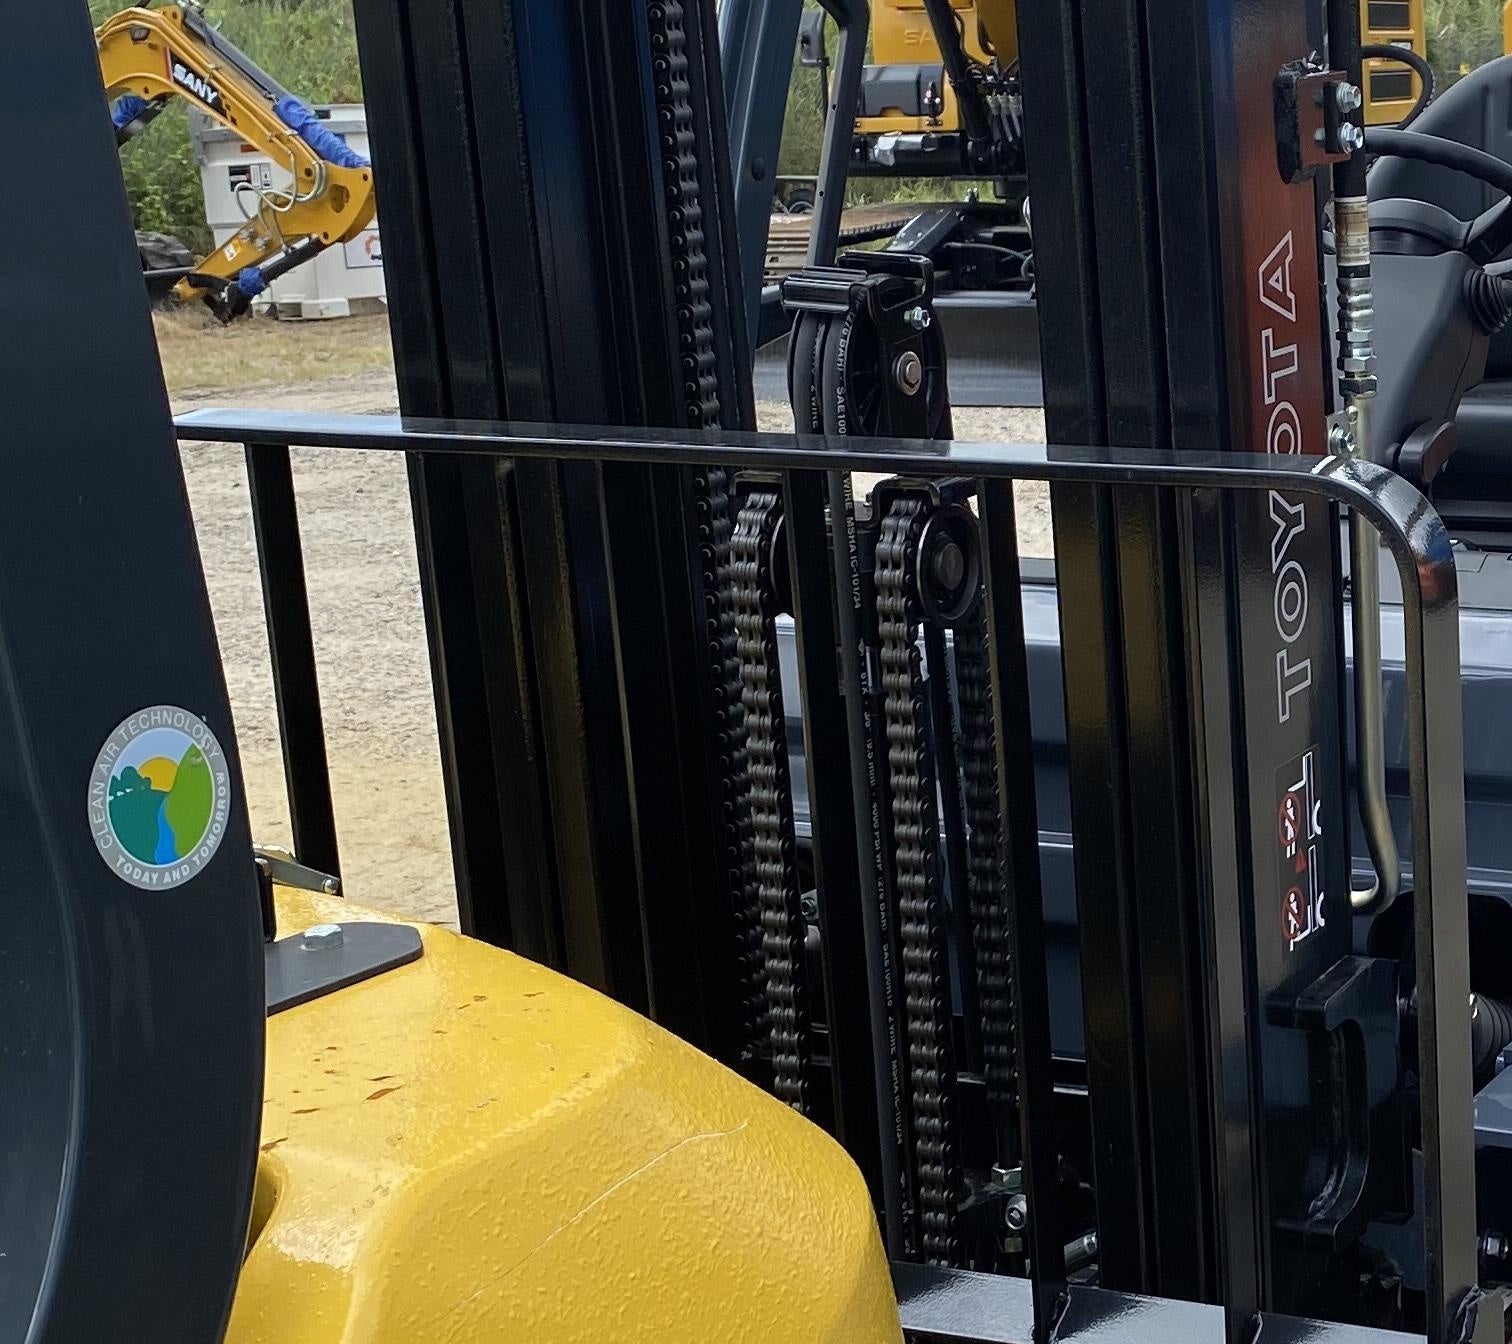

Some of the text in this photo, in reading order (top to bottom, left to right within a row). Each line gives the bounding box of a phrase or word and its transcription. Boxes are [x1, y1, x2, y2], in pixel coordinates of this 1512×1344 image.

[173, 63, 218, 104] SANY
[1258, 229, 1312, 724] TOYOTA
[98, 742, 120, 775] AIR
[117, 709, 219, 759] TECHNOLOGY
[92, 781, 113, 849] CLEAN
[115, 771, 227, 885] TODAY AND TOMORROW
